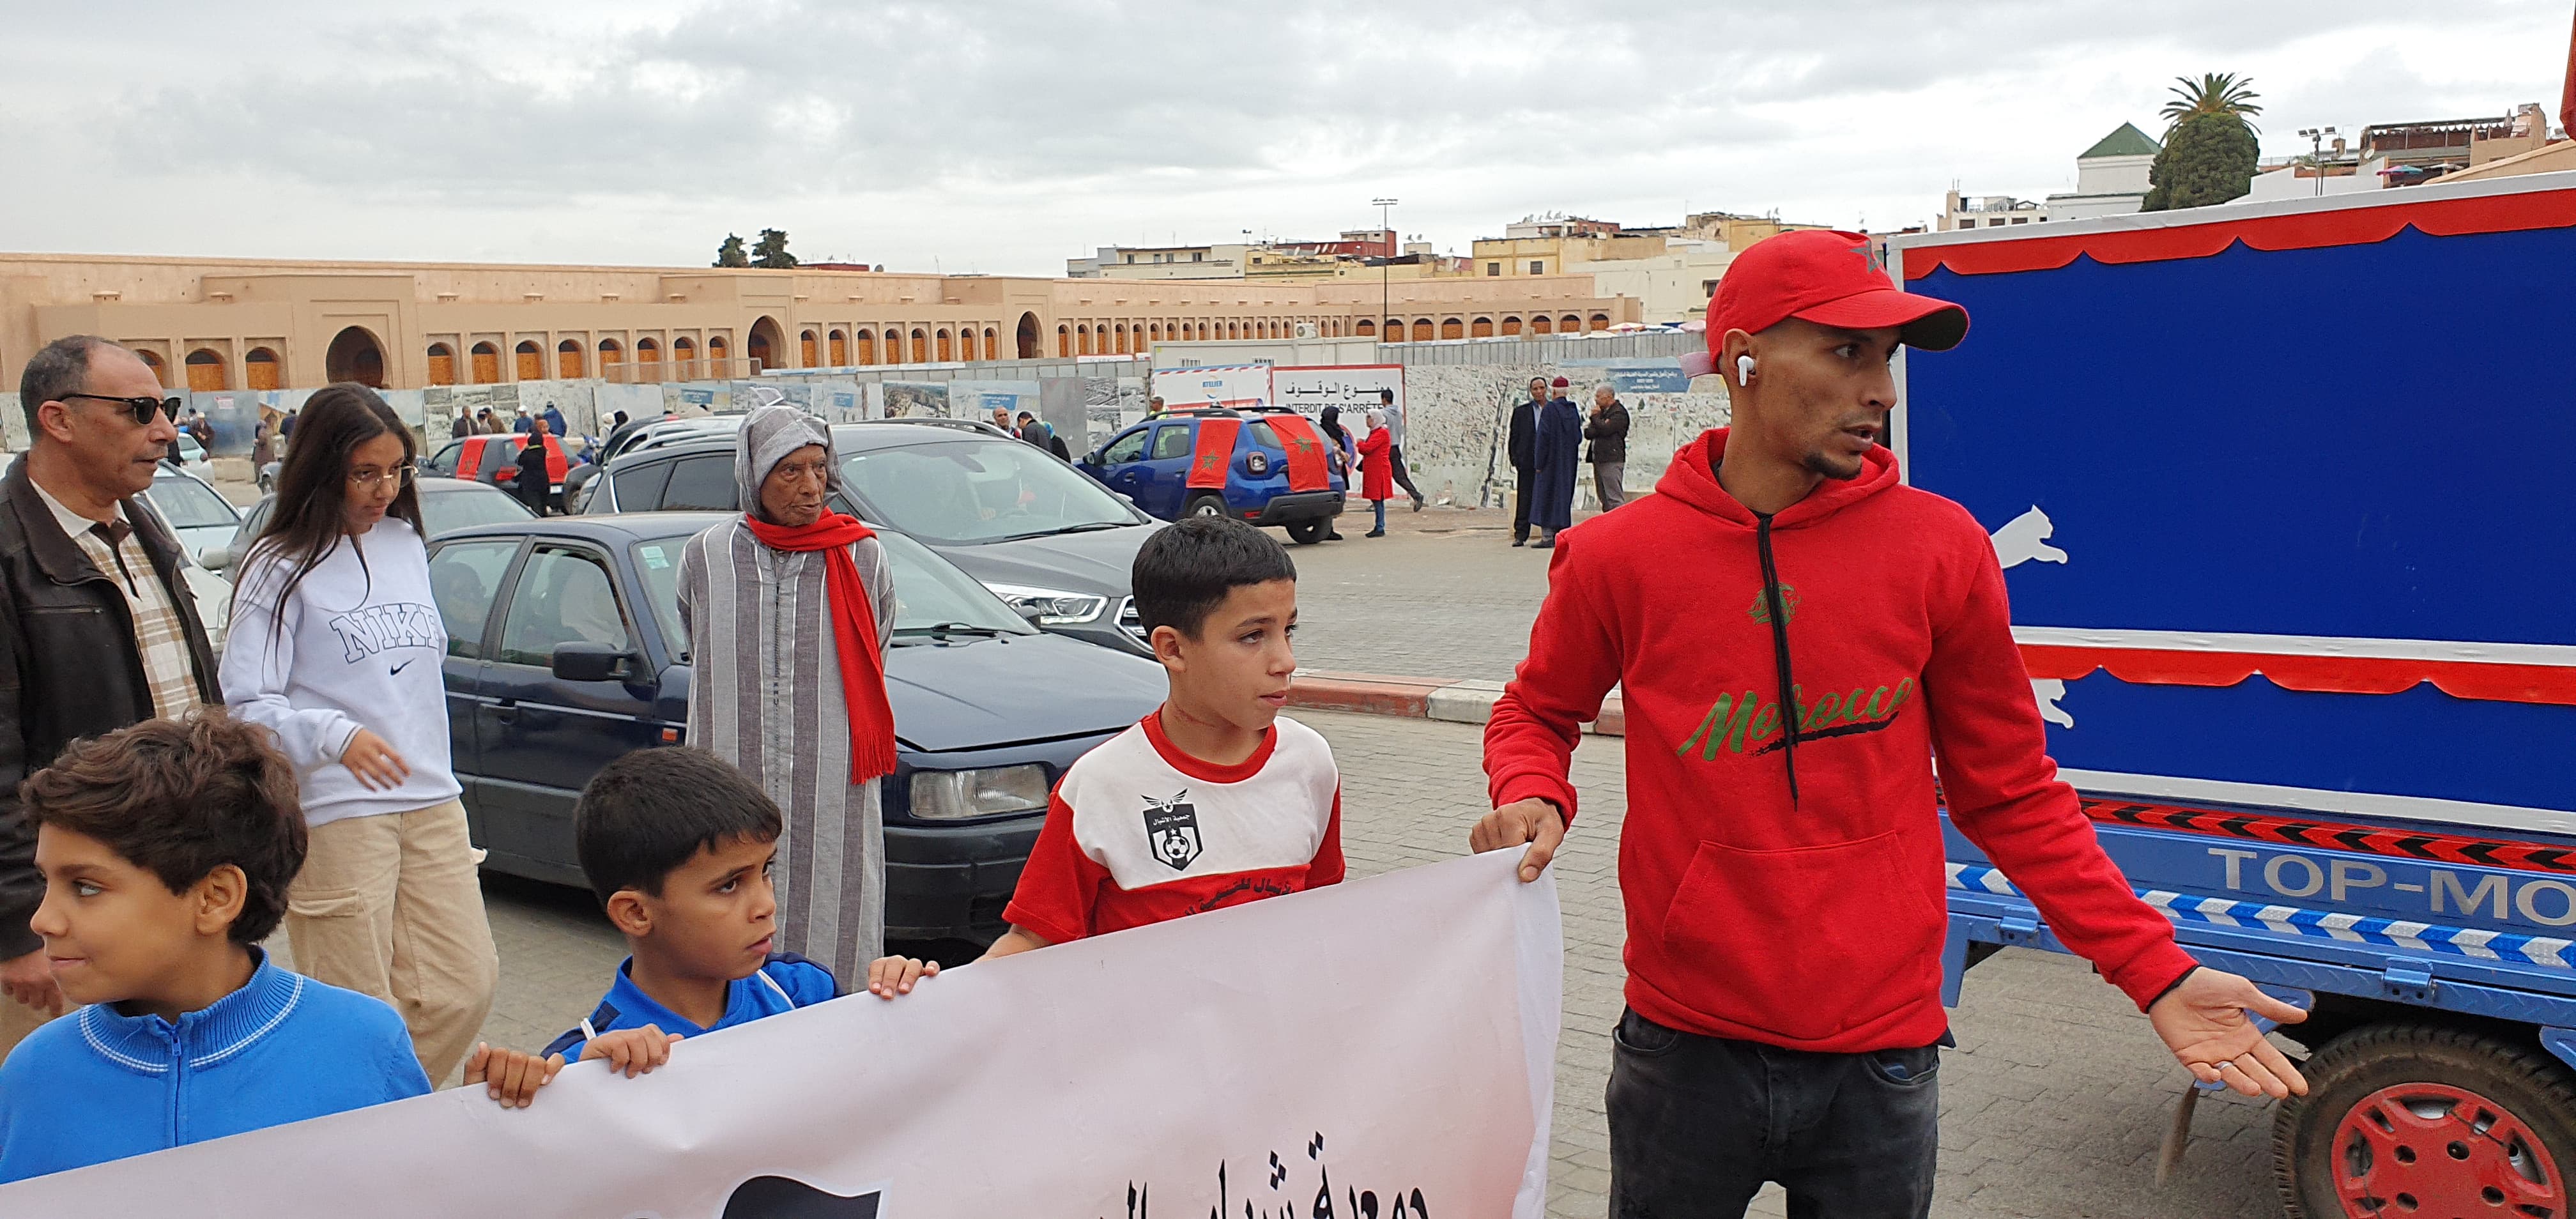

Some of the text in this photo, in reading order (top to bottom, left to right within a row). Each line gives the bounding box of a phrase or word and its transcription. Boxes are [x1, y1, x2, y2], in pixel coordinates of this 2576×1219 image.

[1285, 380, 1340, 397] الوقوف
[329, 602, 440, 664] NIKE
[1676, 677, 1914, 761] Morocco
